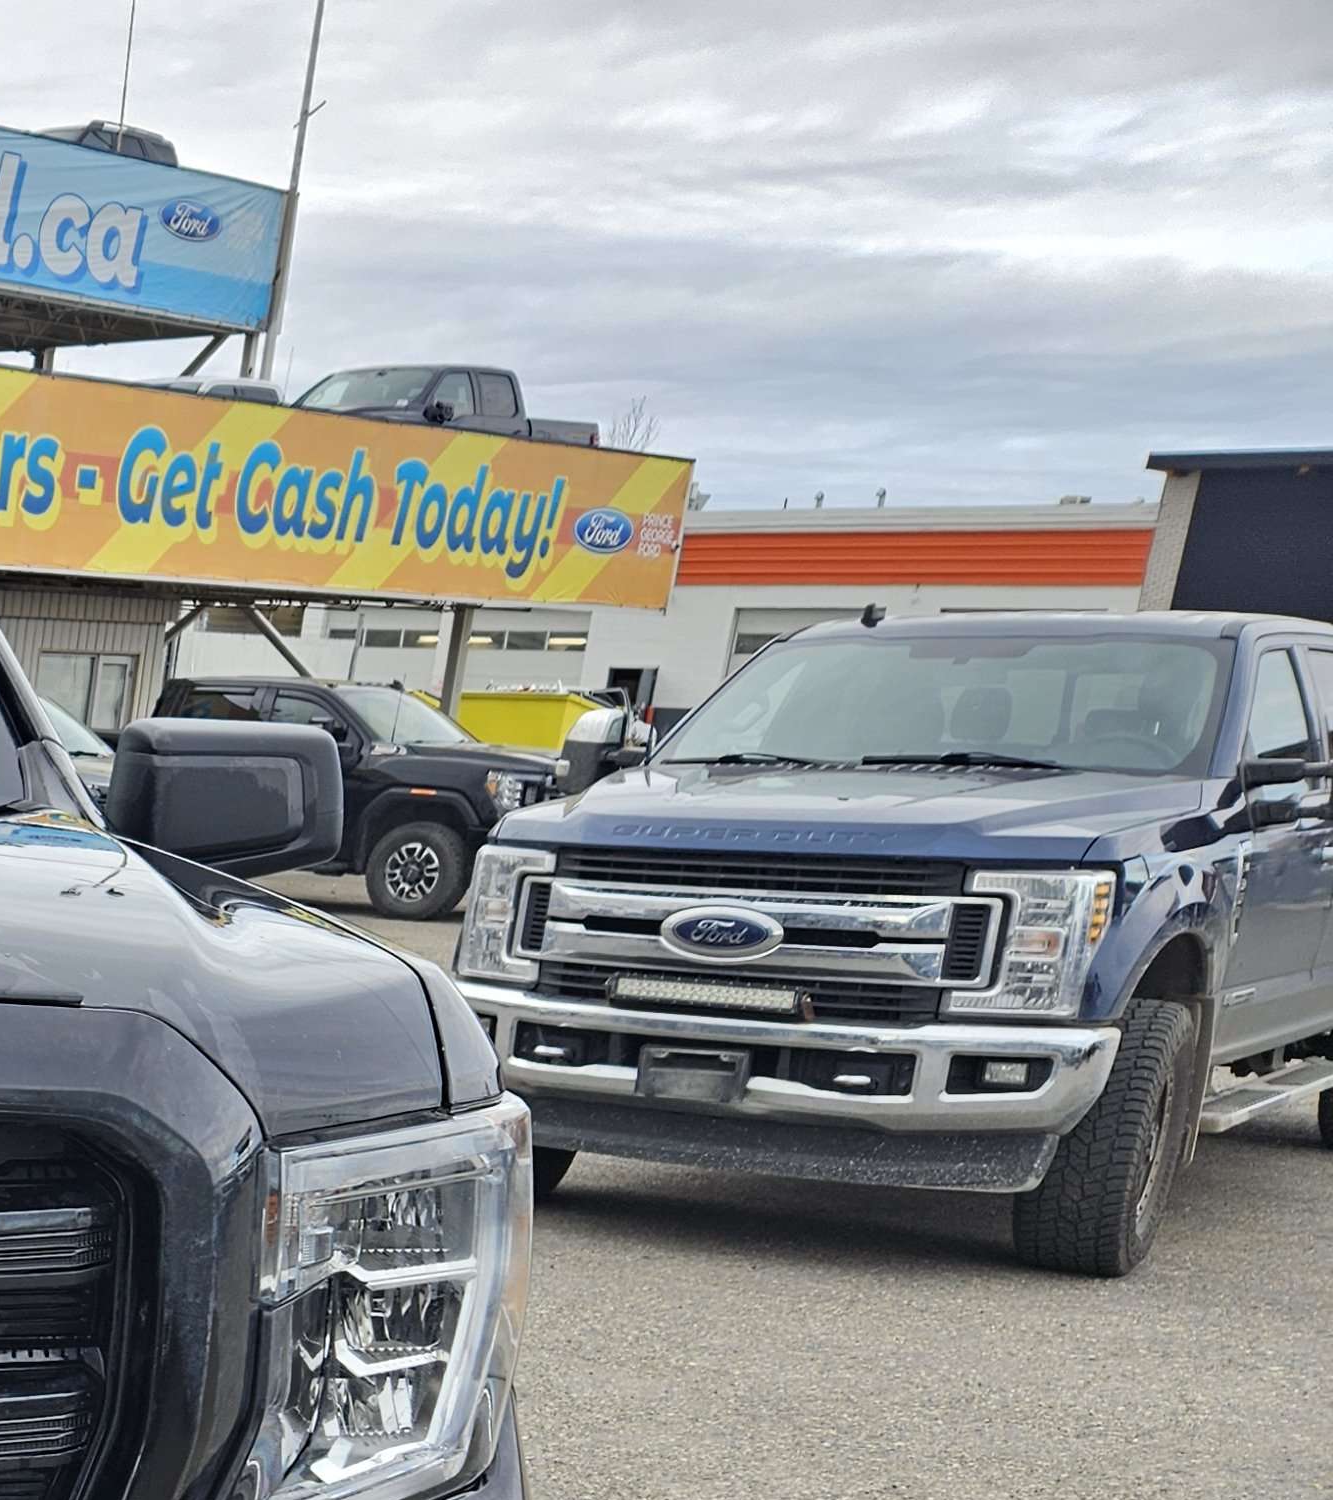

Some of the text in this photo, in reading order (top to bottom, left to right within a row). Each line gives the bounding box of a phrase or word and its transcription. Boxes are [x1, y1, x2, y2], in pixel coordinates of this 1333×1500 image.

[116, 425, 223, 531] Get
[235, 440, 376, 544] Cash
[390, 458, 568, 580] Today!
[641, 511, 675, 529] PRINCE
[639, 526, 676, 545] GEORGE
[636, 540, 662, 558] FORD
[612, 824, 899, 845] SUPER DUTY
